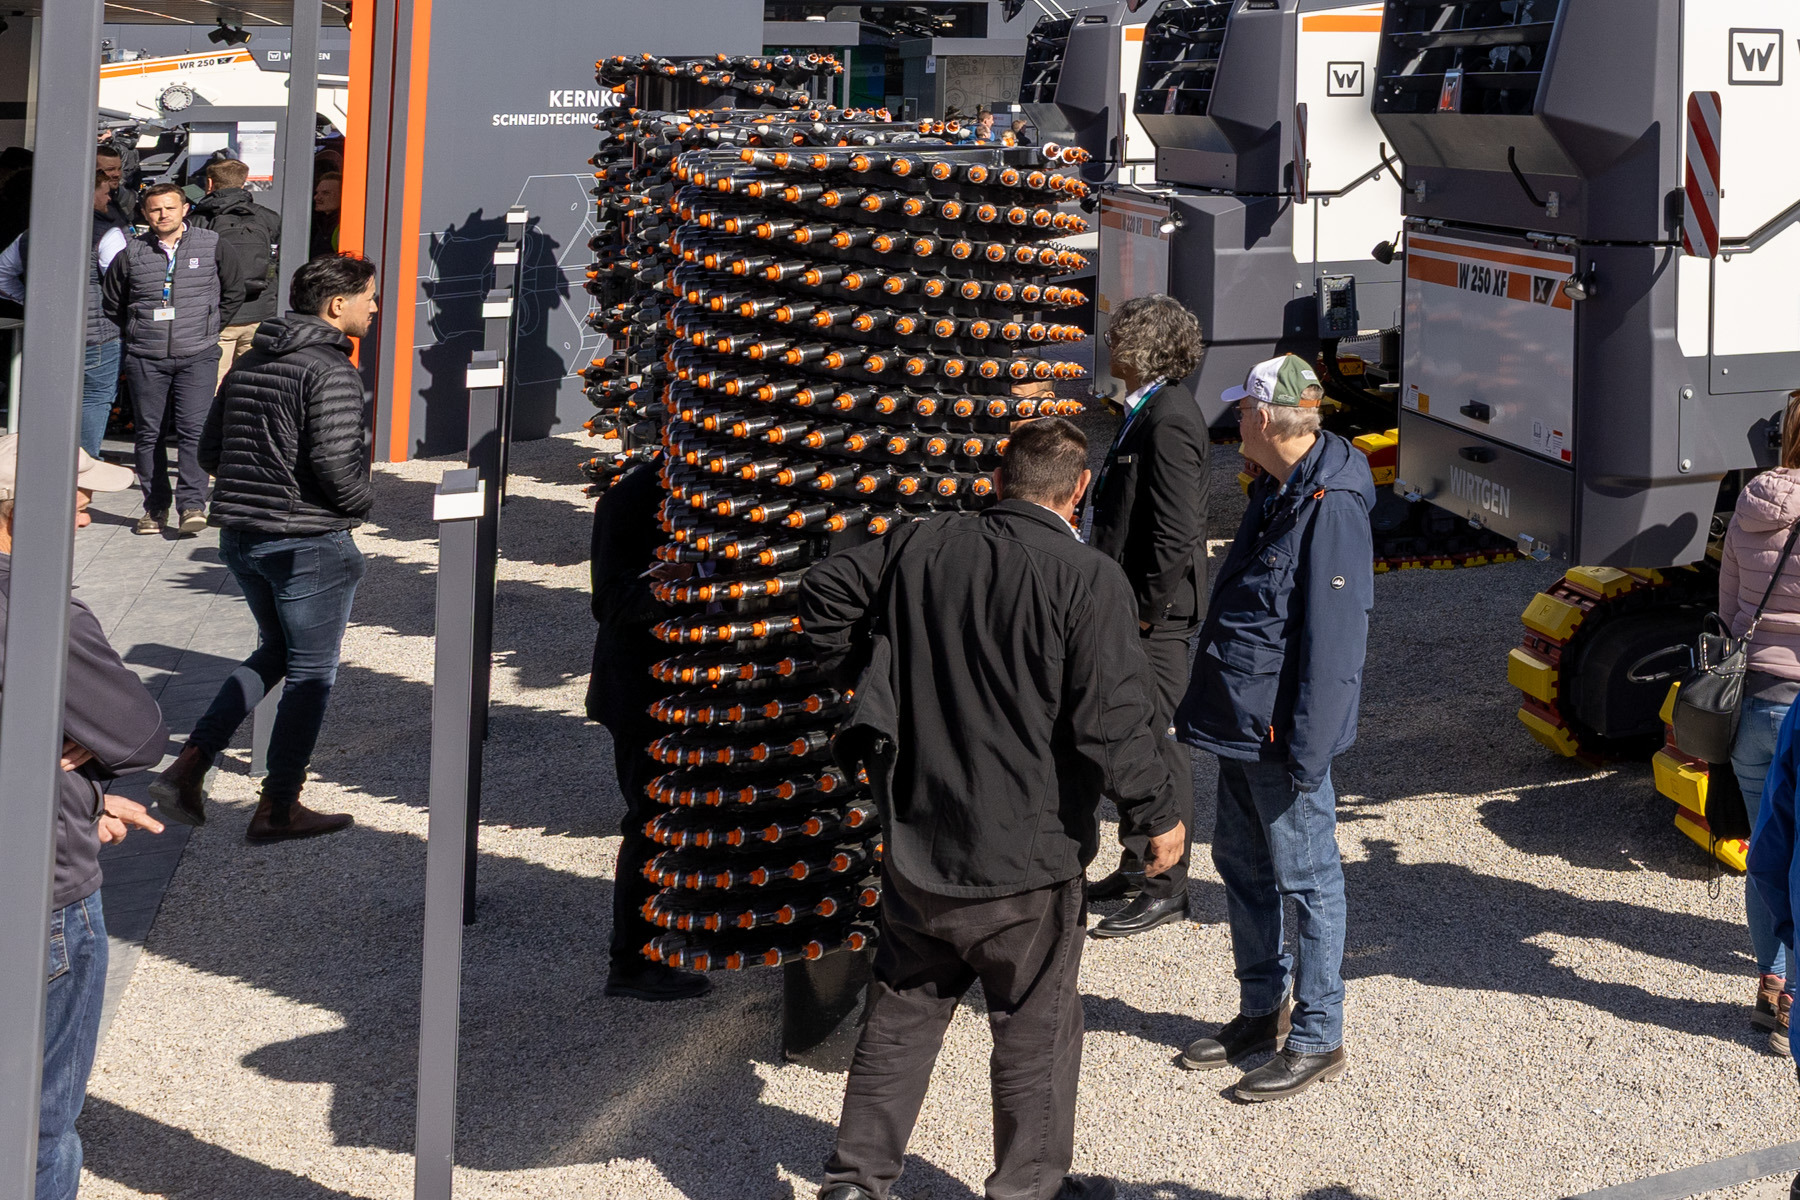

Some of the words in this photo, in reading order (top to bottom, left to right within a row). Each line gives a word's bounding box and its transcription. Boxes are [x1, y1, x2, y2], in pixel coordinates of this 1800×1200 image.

[180, 61, 195, 70] WR
[197, 58, 215, 68] 250
[1459, 262, 1470, 290] W
[1471, 265, 1491, 295] 250
[1492, 269, 1508, 298] XF
[1450, 464, 1510, 518] WIRTGEN
